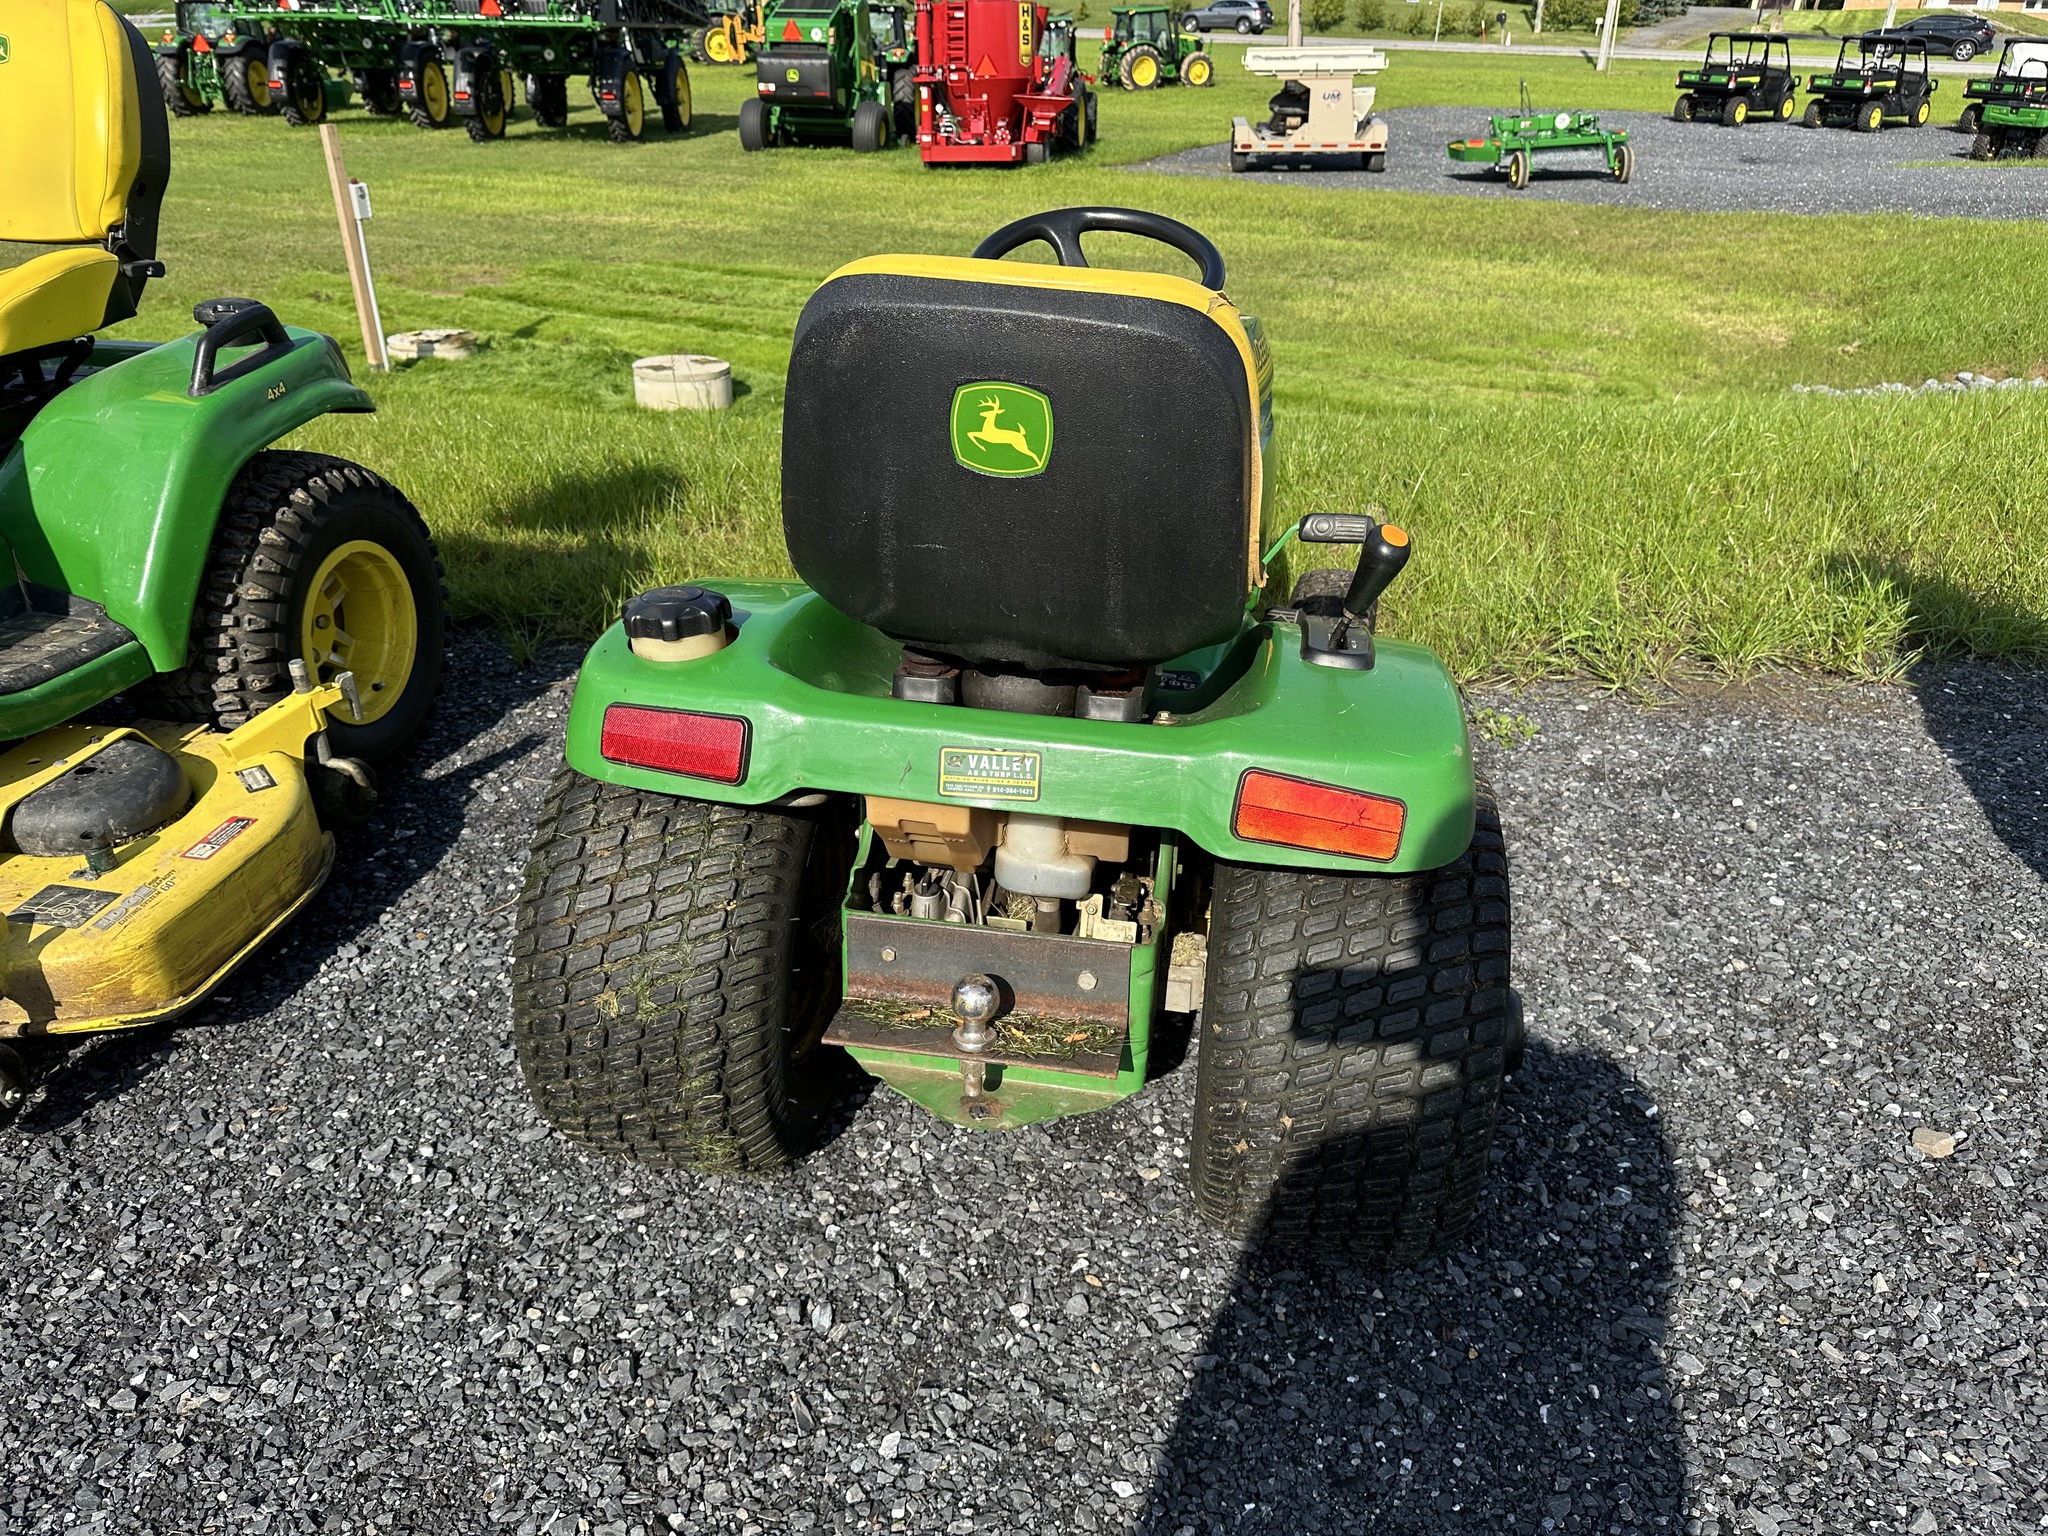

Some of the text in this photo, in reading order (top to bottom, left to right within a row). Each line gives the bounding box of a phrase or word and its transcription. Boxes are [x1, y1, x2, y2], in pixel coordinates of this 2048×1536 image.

[267, 381, 286, 400] 4x4
[968, 754, 1034, 772] VALLEY
[967, 769, 979, 777] AG
[989, 770, 1011, 778] TURF
[91, 885, 157, 931] EDGE
[152, 869, 177, 888] CAPACITY
[118, 907, 142, 926] CUTTING
[141, 891, 162, 908] SYSTEM
